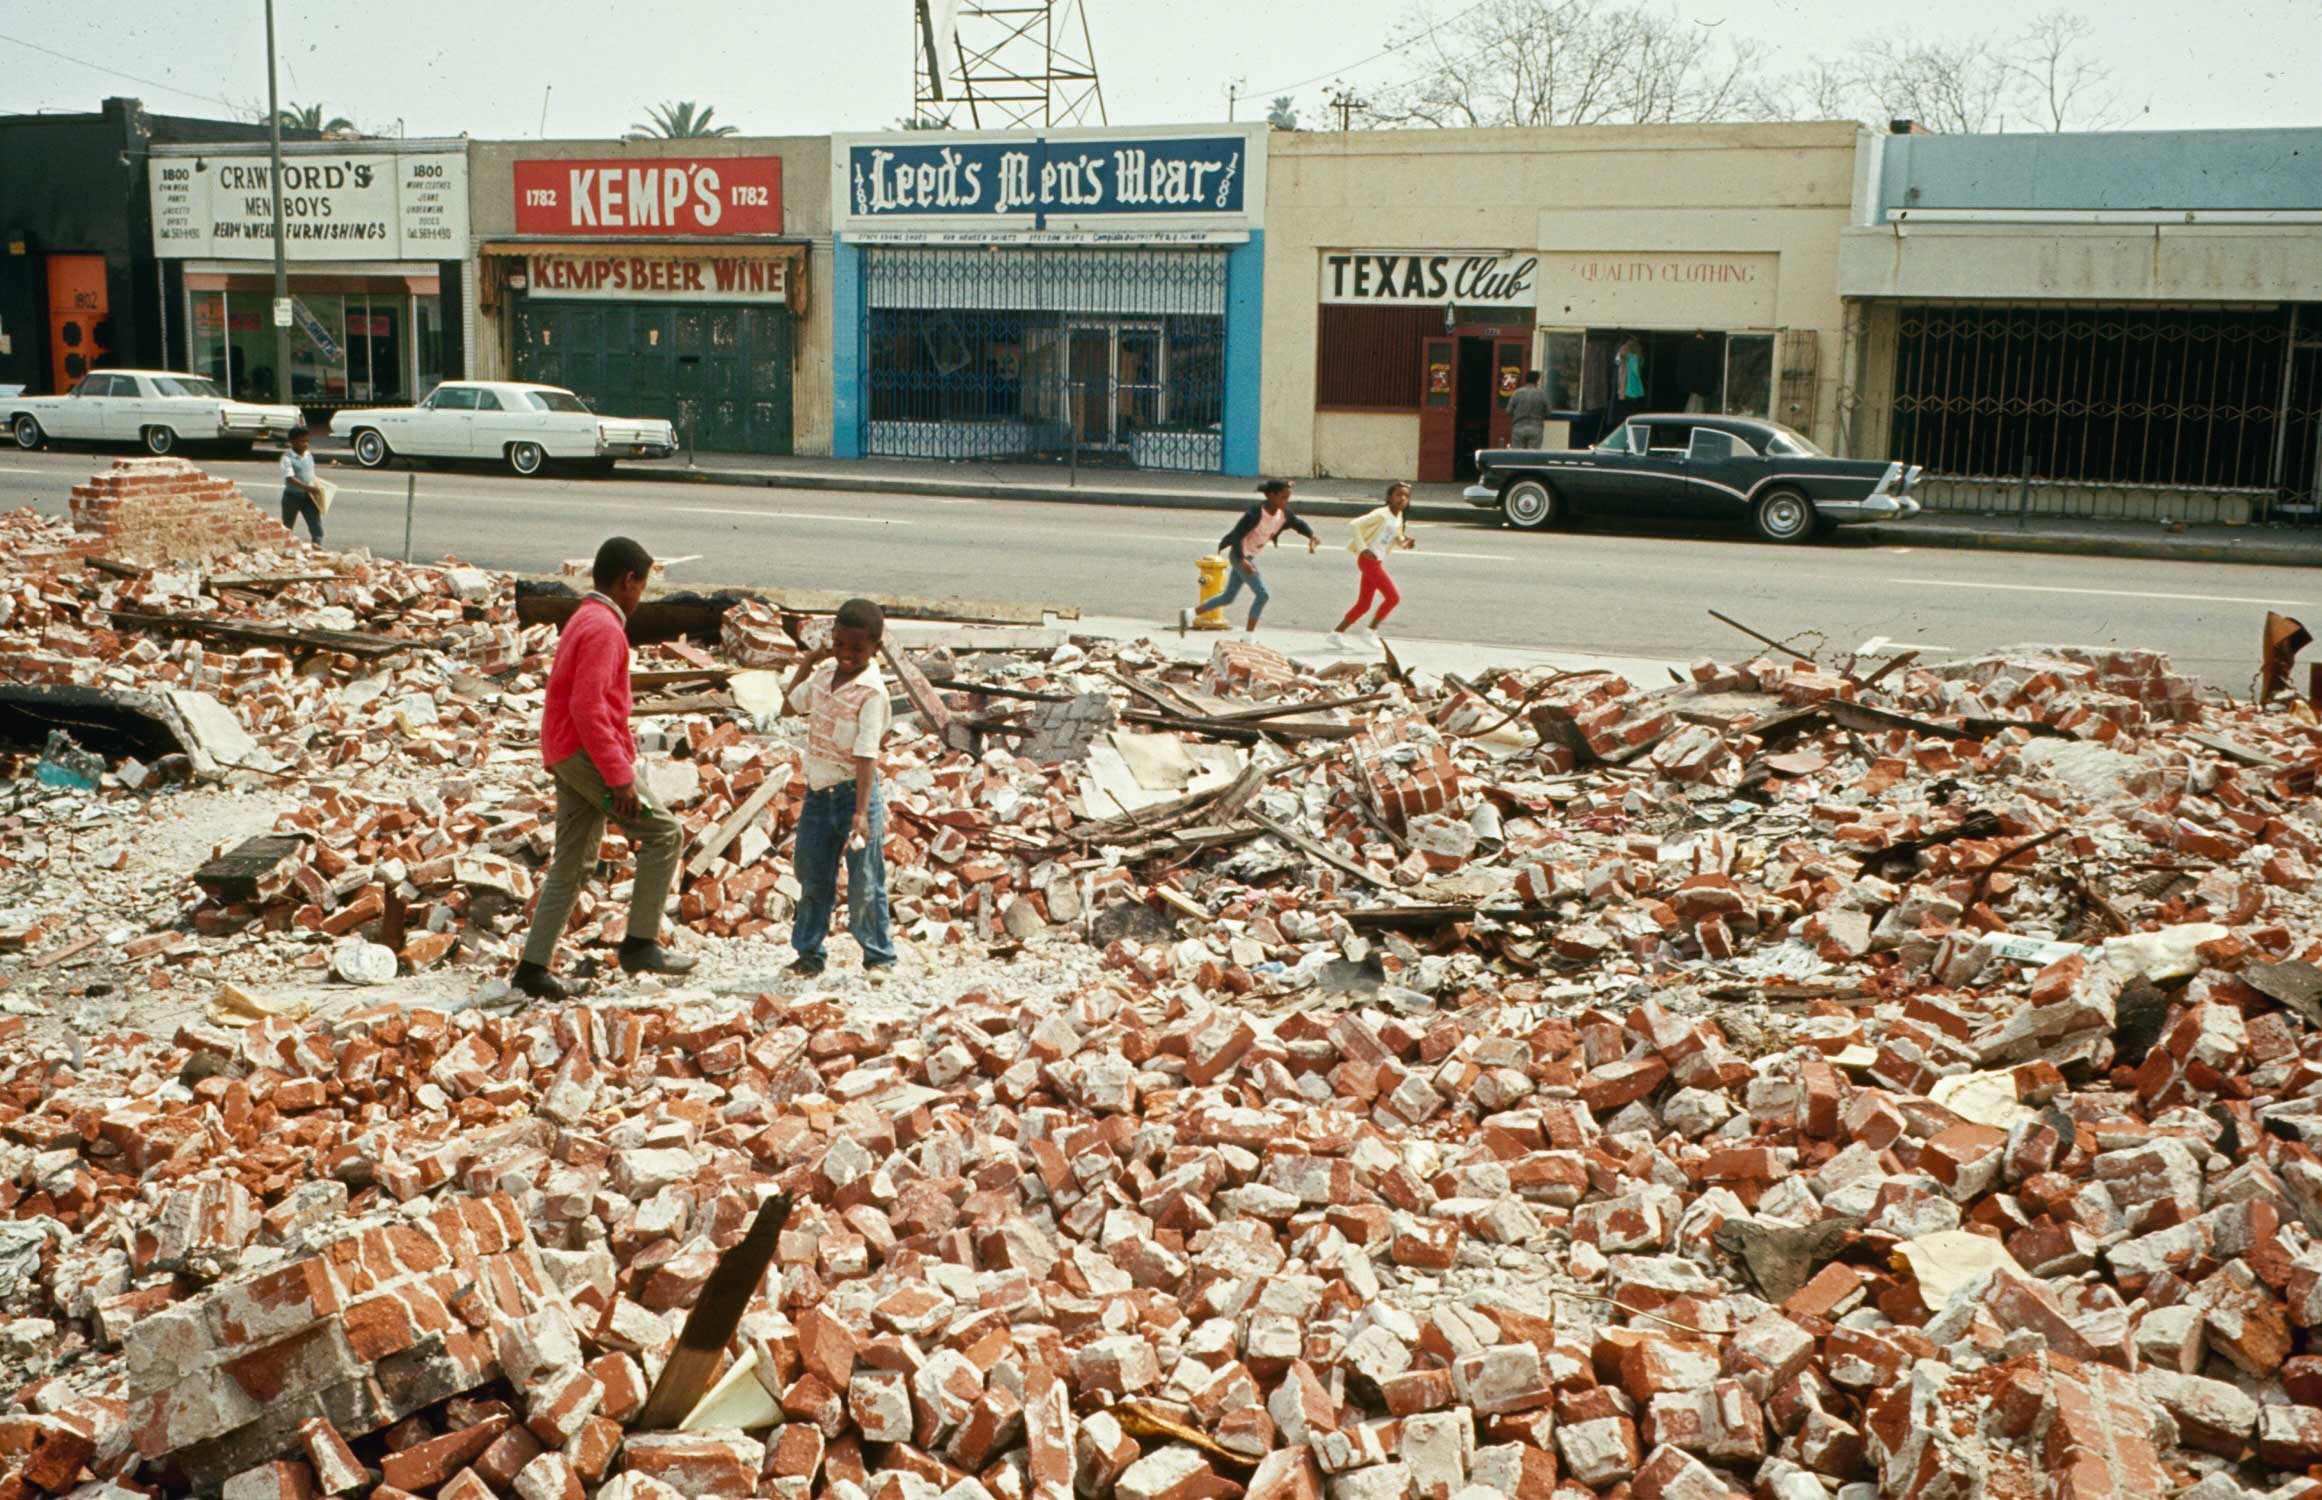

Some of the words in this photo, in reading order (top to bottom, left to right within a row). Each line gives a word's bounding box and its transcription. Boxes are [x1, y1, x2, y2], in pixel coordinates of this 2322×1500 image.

[163, 168, 189, 181] 1800
[220, 161, 373, 190] CRAWORD'S
[414, 164, 443, 178] 1800
[869, 147, 982, 213] Leed's
[995, 152, 1104, 213] Men's
[1114, 149, 1222, 205] Wear
[1216, 152, 1239, 208] 1780
[526, 189, 557, 207] 1782
[569, 163, 722, 227] KEMP'S
[731, 186, 768, 206] 1782
[854, 163, 868, 214] 1780
[245, 197, 272, 217] MEN
[284, 196, 332, 217] BOYS
[212, 221, 242, 239] READY
[286, 222, 386, 240] FURNISHINGS
[533, 256, 628, 290] KEMP'S
[631, 258, 705, 291] BEER
[712, 258, 783, 293] WINE
[1328, 255, 1448, 298] TEXAS
[1454, 256, 1538, 299] Club
[1581, 263, 1654, 282] QUALITY
